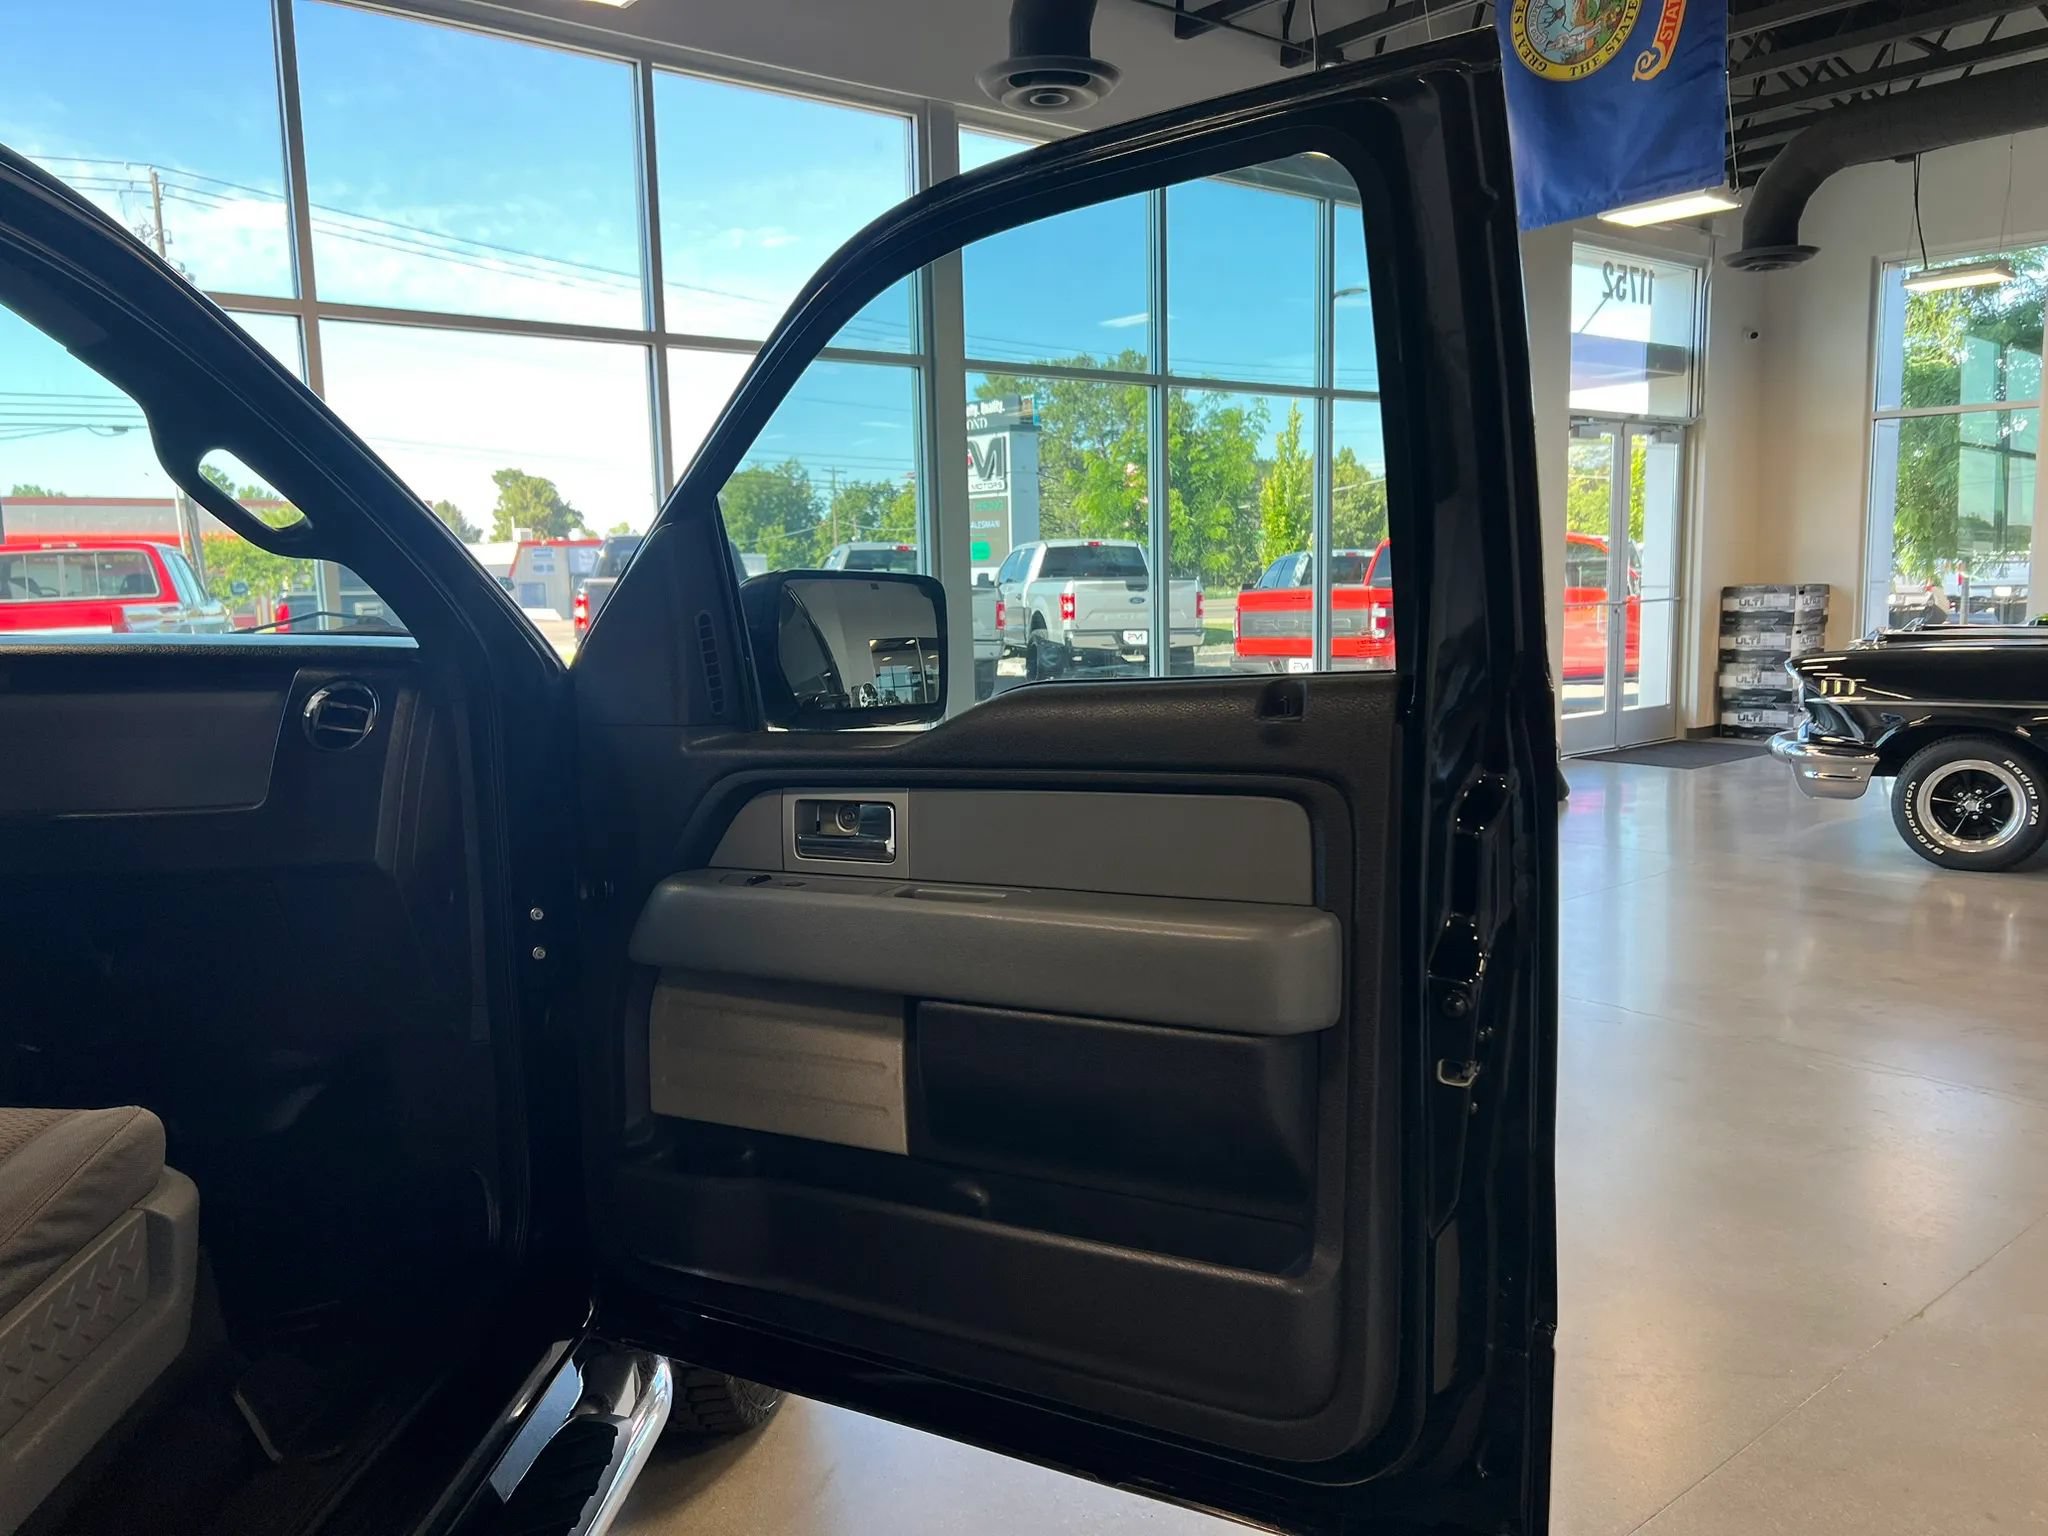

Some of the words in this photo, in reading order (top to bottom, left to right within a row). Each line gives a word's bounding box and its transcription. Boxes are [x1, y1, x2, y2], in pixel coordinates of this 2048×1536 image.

[1513, 0, 1527, 24] SE
[1569, 54, 1602, 76] THE
[1605, 2, 1638, 55] STATE
[1515, 31, 1548, 72] GREAT
[1905, 781, 1944, 855] BFGoodrich
[2003, 760, 2038, 799] Radial
[2029, 804, 2039, 825] T/A
